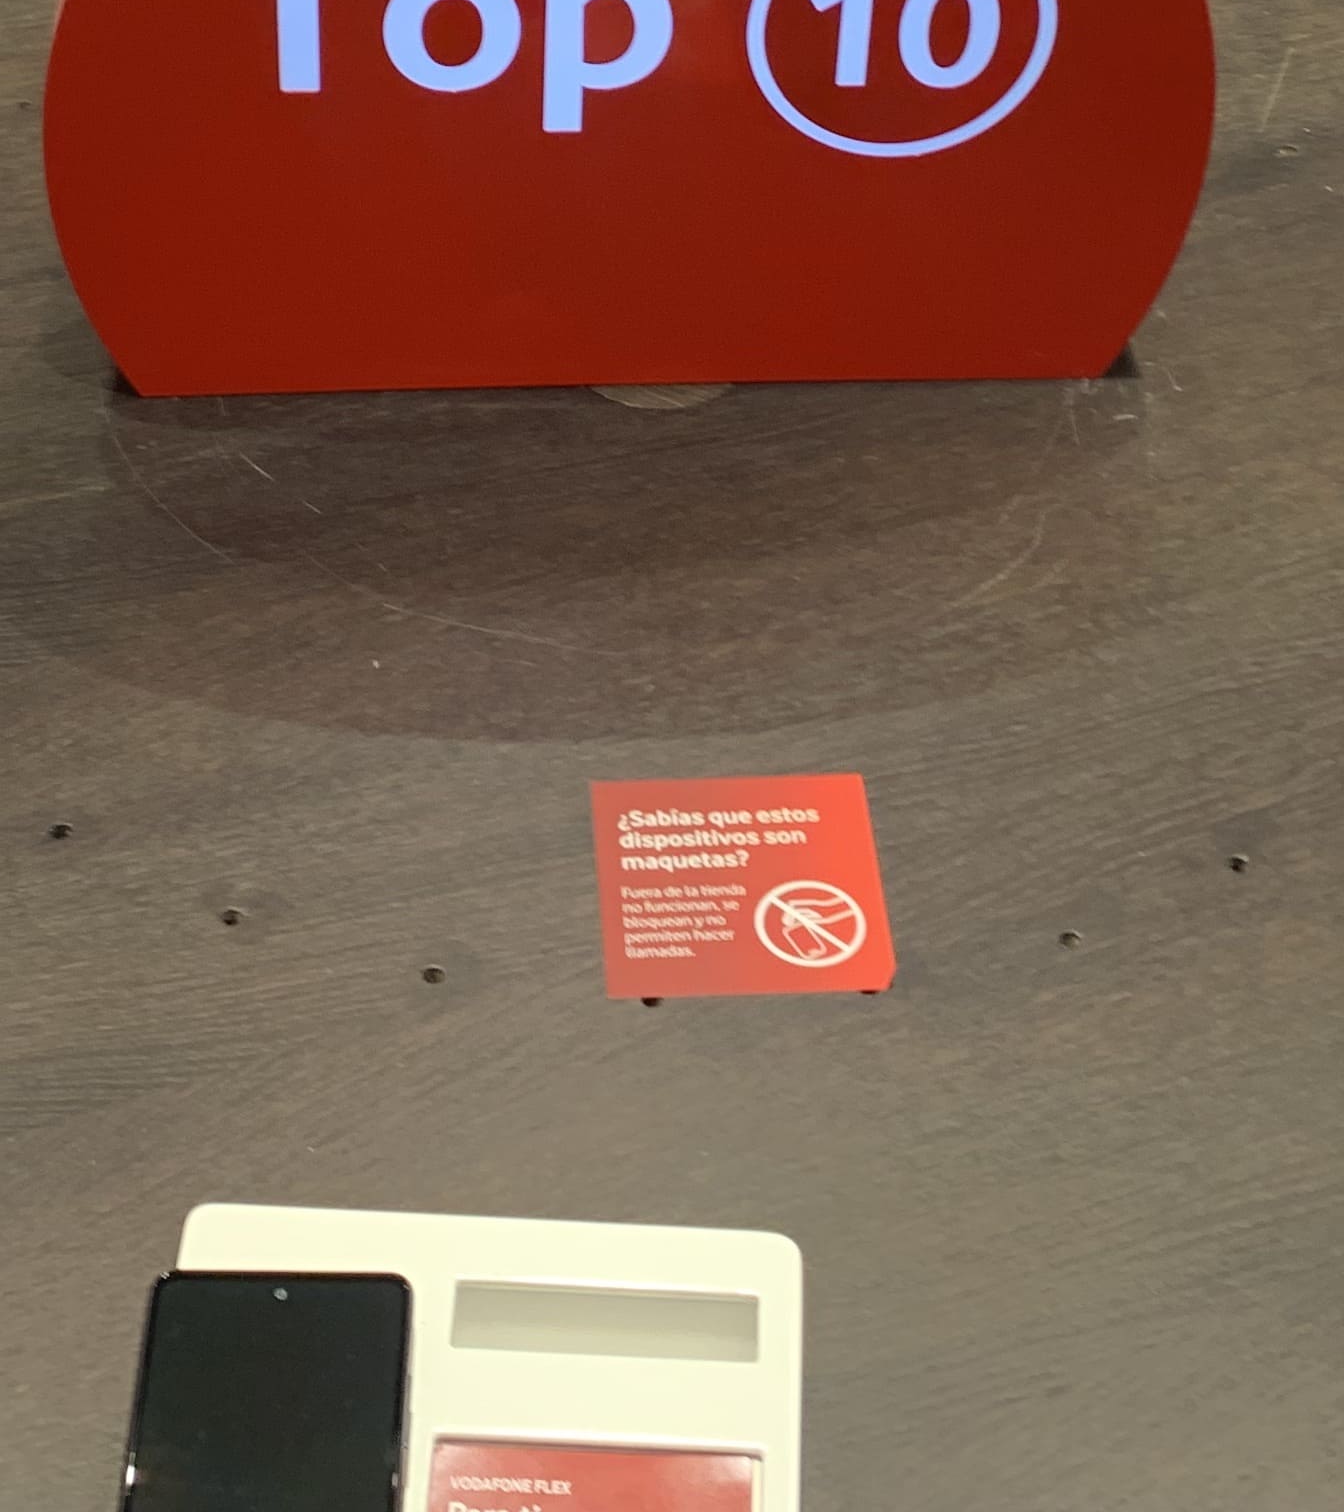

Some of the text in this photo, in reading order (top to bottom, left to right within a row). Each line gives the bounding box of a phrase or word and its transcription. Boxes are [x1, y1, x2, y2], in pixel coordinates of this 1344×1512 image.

[617, 807, 820, 831] ¿Sabías que estos
[619, 829, 807, 851] dispositivos son
[621, 850, 749, 872] maquetas?
[620, 884, 747, 899] Fuera de la tienda
[621, 899, 739, 914] no funcionan, se
[622, 915, 726, 931] bloquean y no
[624, 929, 734, 945] permiten hacer
[624, 945, 696, 960] llamadas.
[450, 1476, 572, 1496] VODAFONE FLEX
